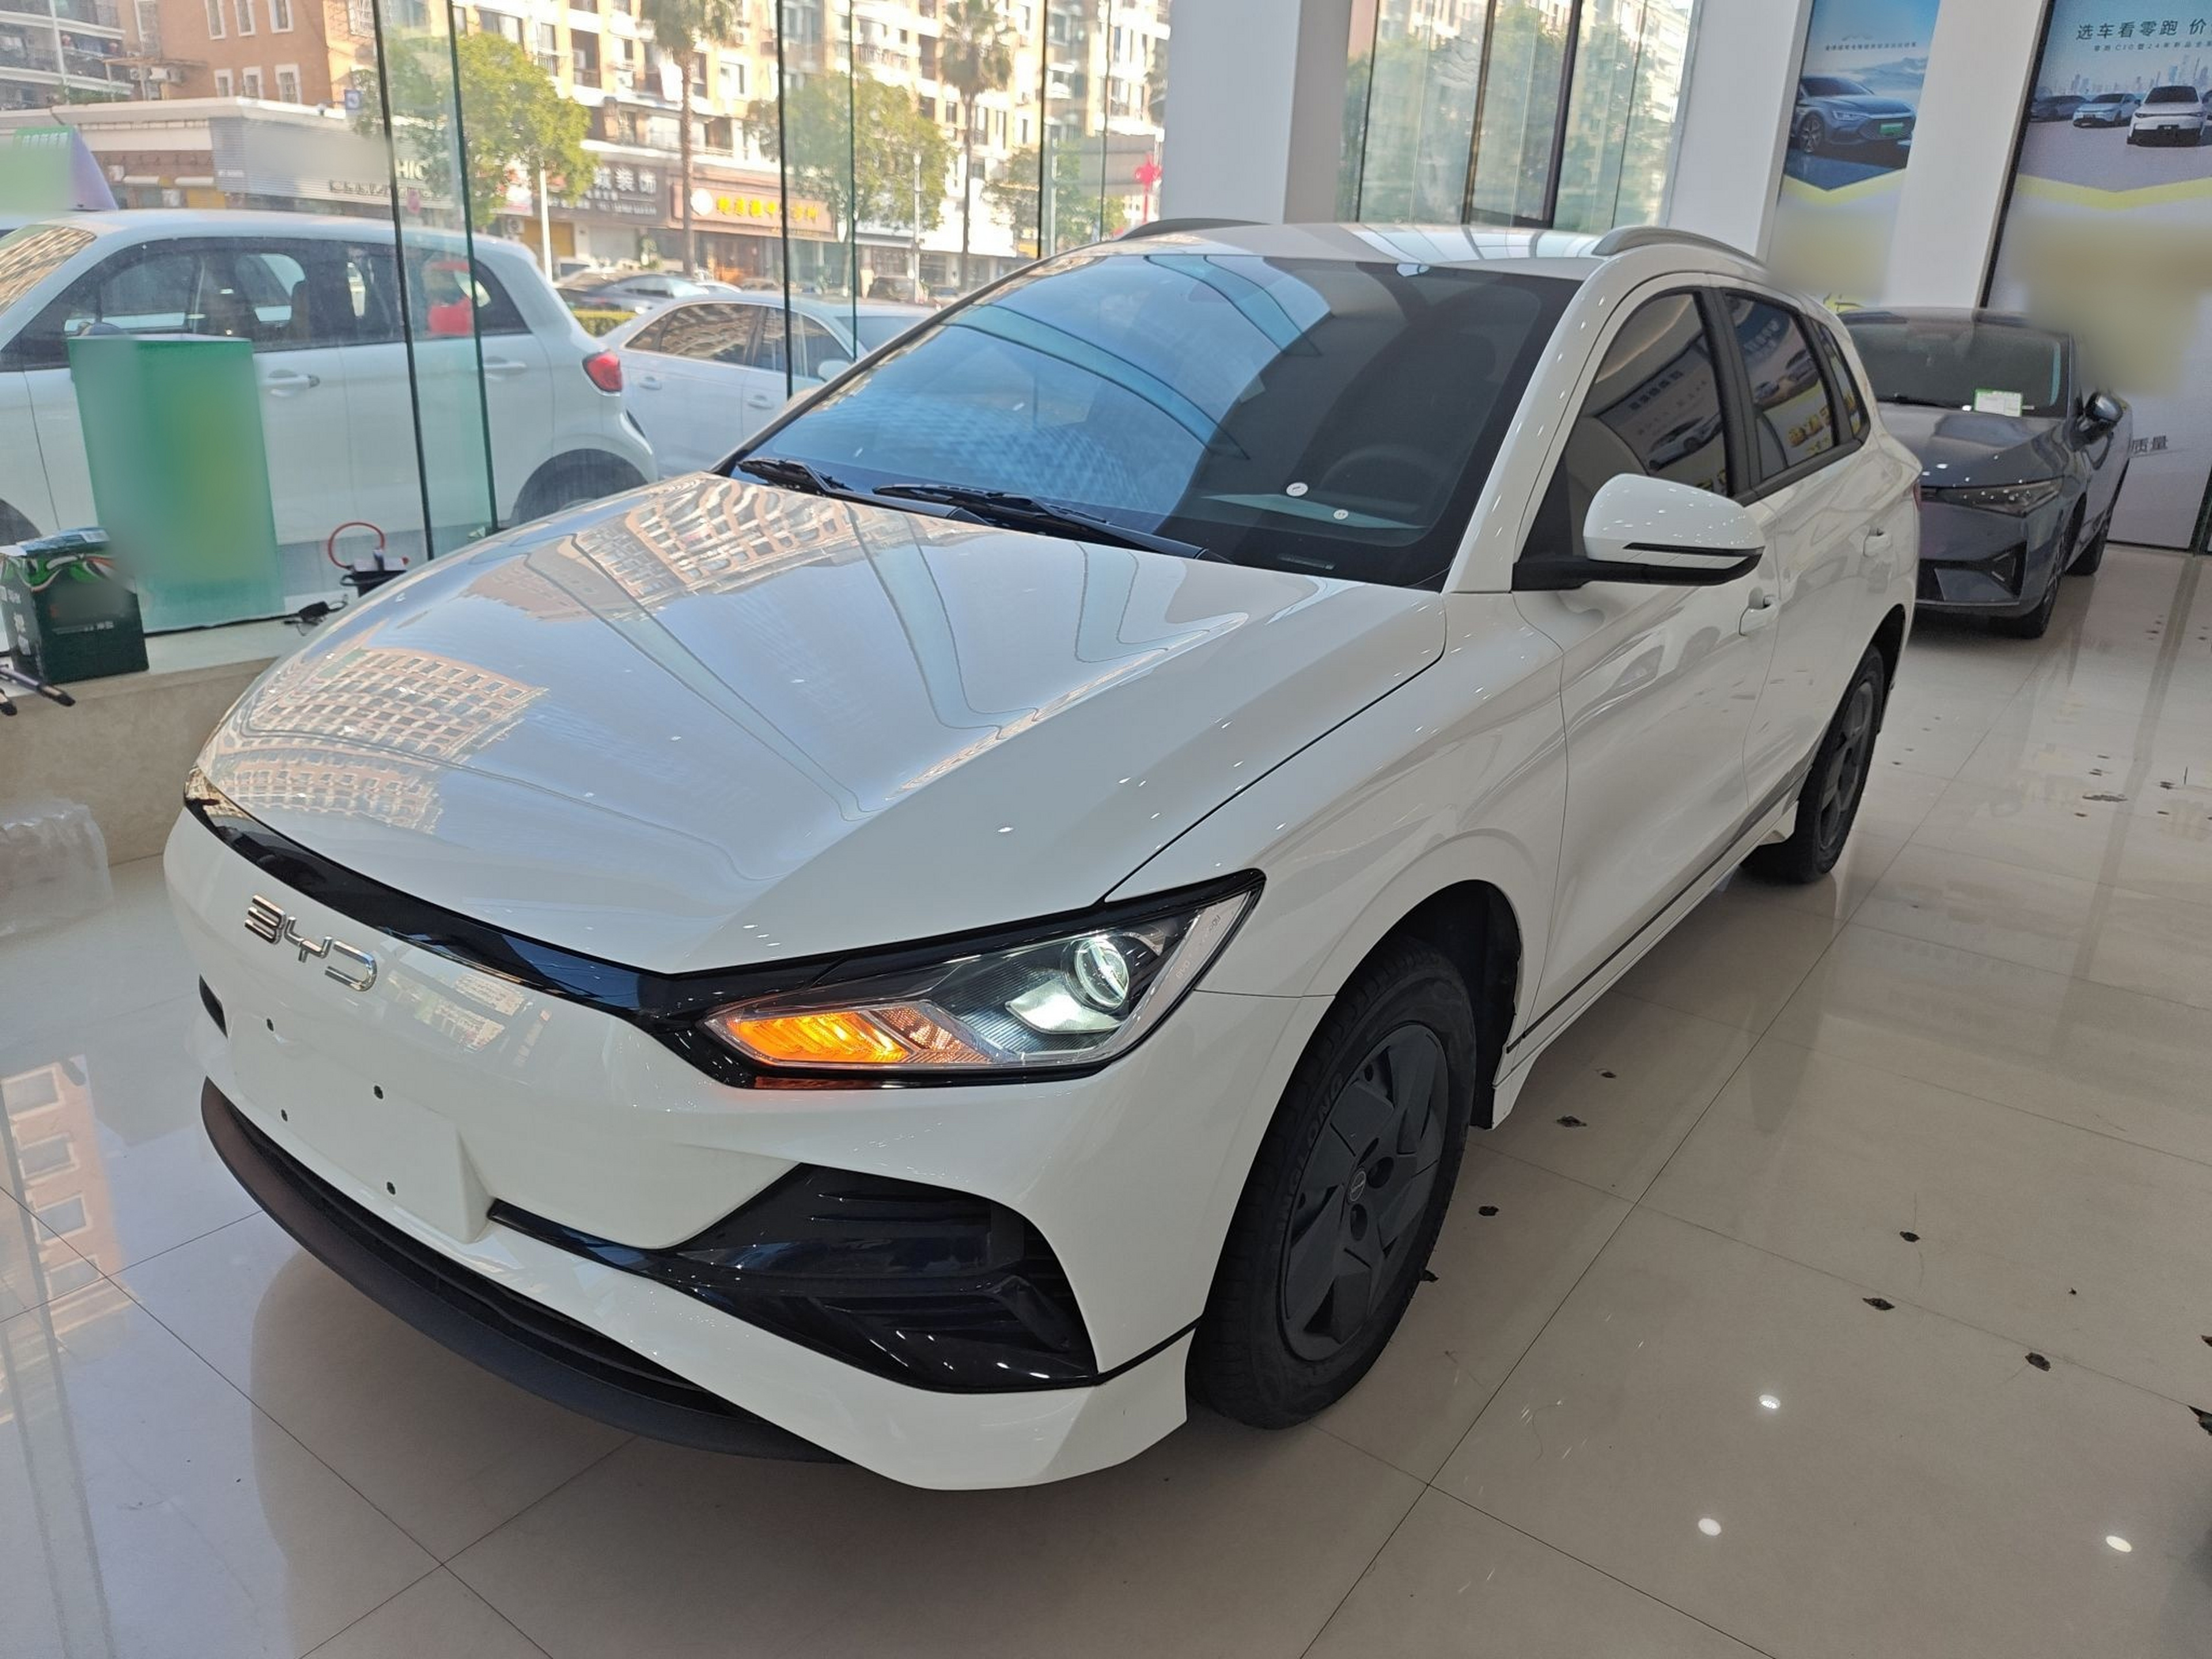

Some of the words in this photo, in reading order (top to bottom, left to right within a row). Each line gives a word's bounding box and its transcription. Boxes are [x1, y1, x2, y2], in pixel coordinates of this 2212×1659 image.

[2075, 20, 2178, 40] 选车看零跑
[2190, 18, 2212, 35] 价
[244, 895, 377, 991] BYD
